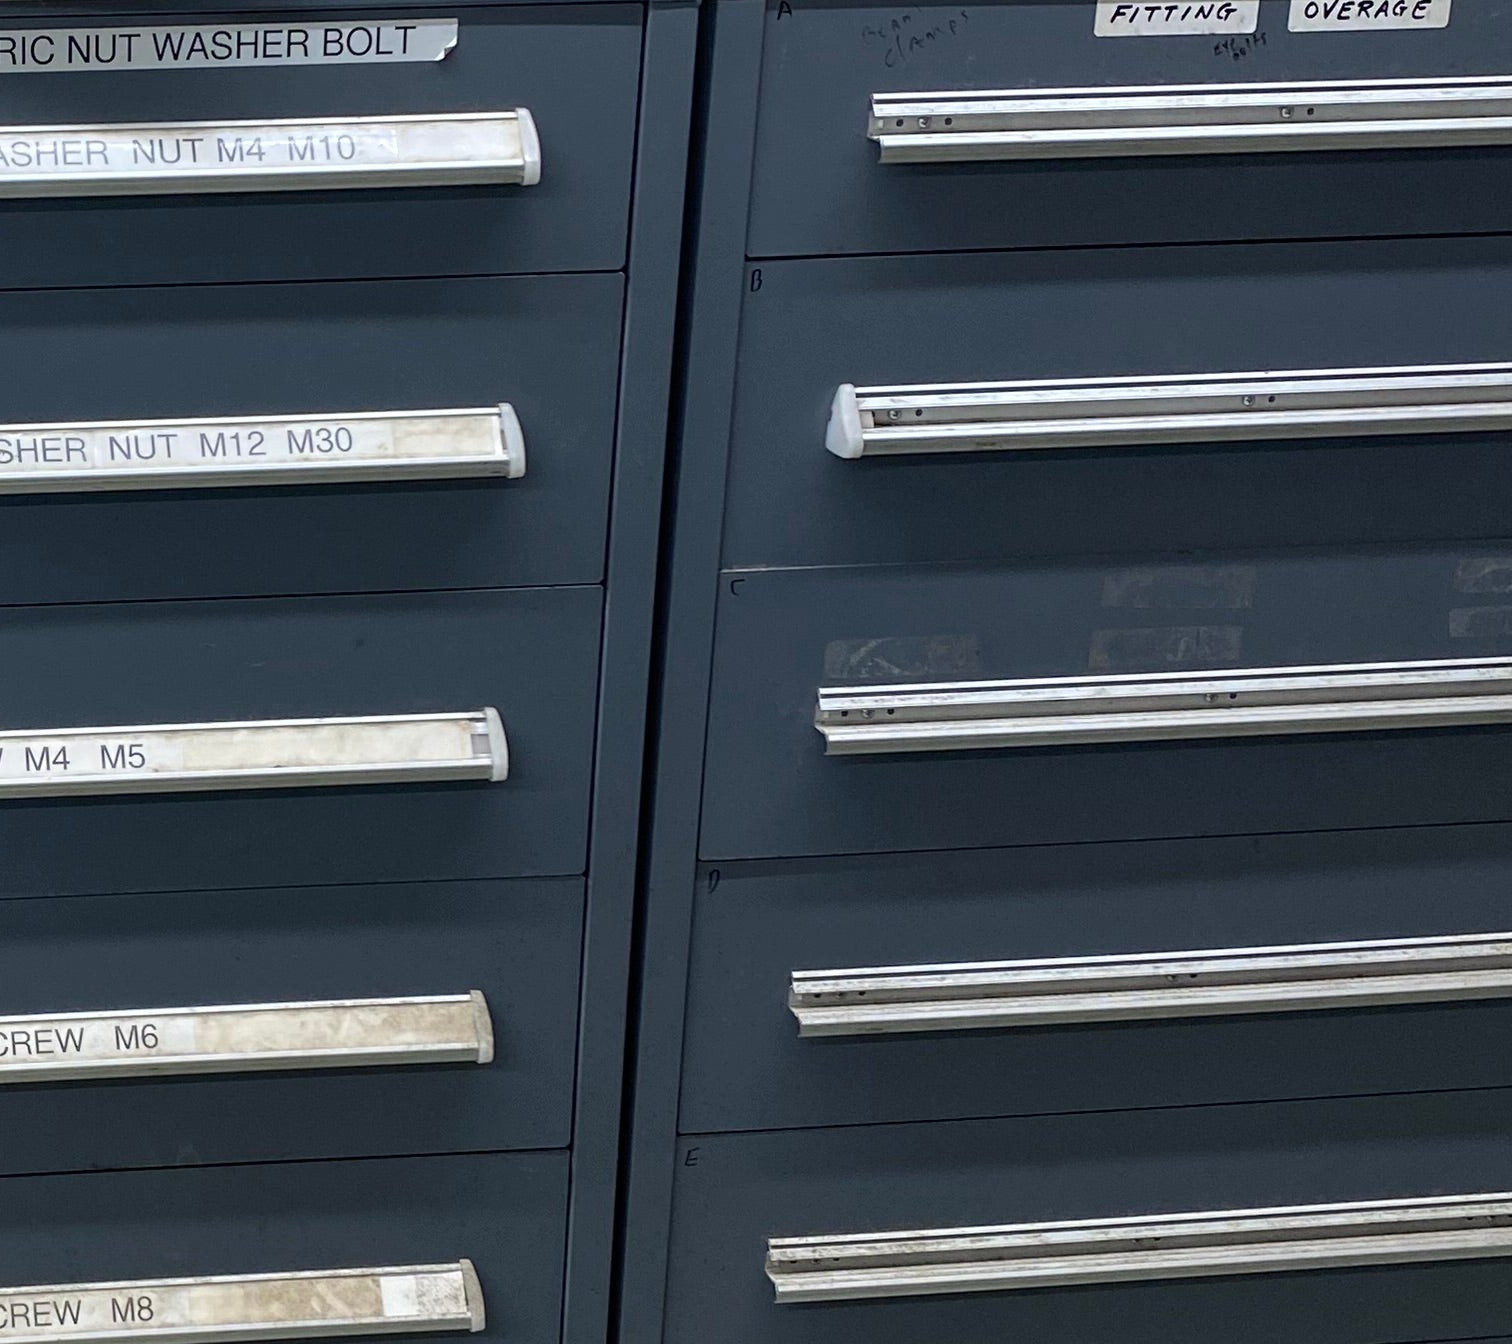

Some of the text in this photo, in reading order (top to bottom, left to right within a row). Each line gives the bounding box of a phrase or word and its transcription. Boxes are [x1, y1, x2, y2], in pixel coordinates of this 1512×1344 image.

[777, 0, 794, 22] A
[1109, 2, 1239, 24] FITTING
[67, 32, 145, 65] NUT
[151, 28, 310, 63] WASHER
[321, 24, 418, 60] BOLT
[132, 134, 207, 166] NUT
[215, 133, 267, 165] M4
[287, 132, 357, 163] M10
[750, 268, 763, 292] B
[107, 433, 179, 463] NUT
[199, 430, 266, 460] M12
[286, 425, 354, 456] M30
[24, 743, 71, 774] M4
[99, 740, 147, 771] M5
[113, 1021, 160, 1052] M6
[684, 1147, 700, 1167] E
[110, 1294, 155, 1325] M8
